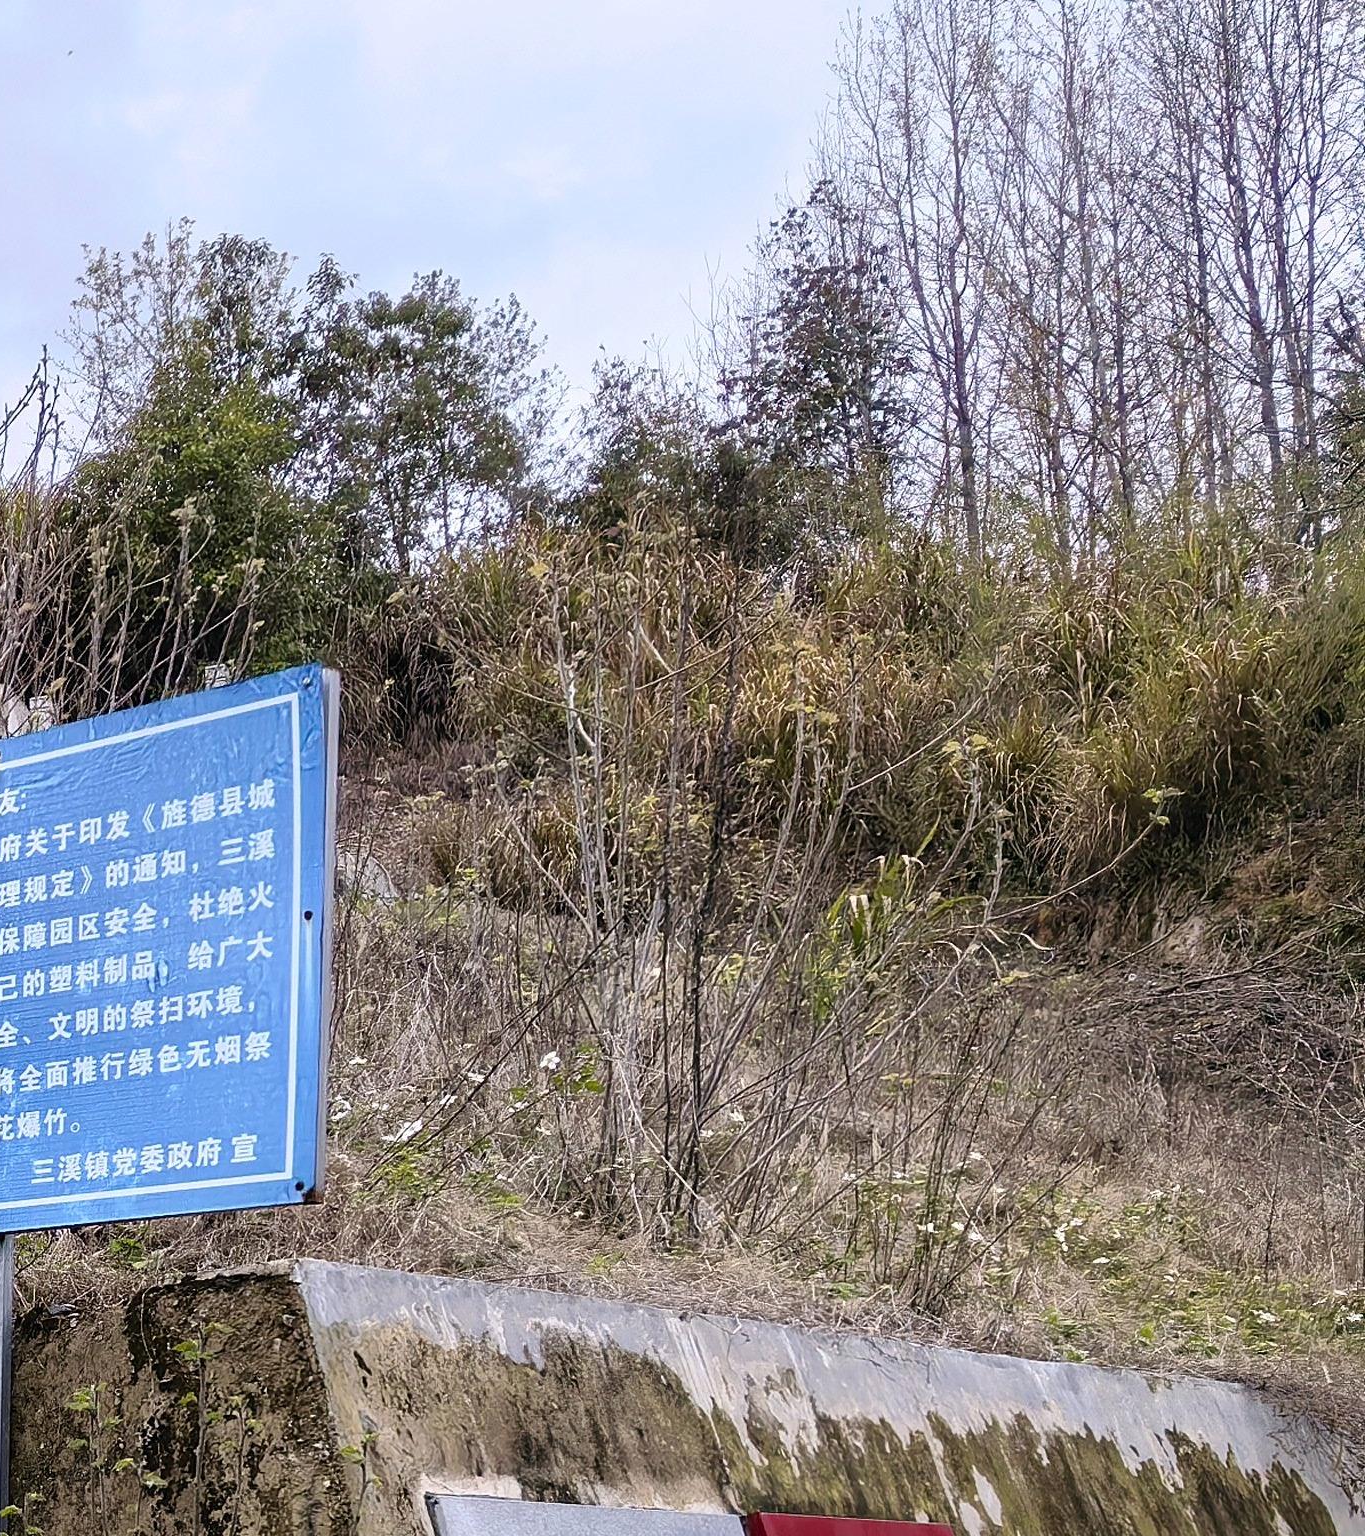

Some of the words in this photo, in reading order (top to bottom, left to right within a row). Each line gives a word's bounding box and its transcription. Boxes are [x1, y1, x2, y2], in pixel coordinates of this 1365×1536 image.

[31, 1137, 222, 1184] 三溪镇党委政府
[230, 1134, 258, 1163] 宣
